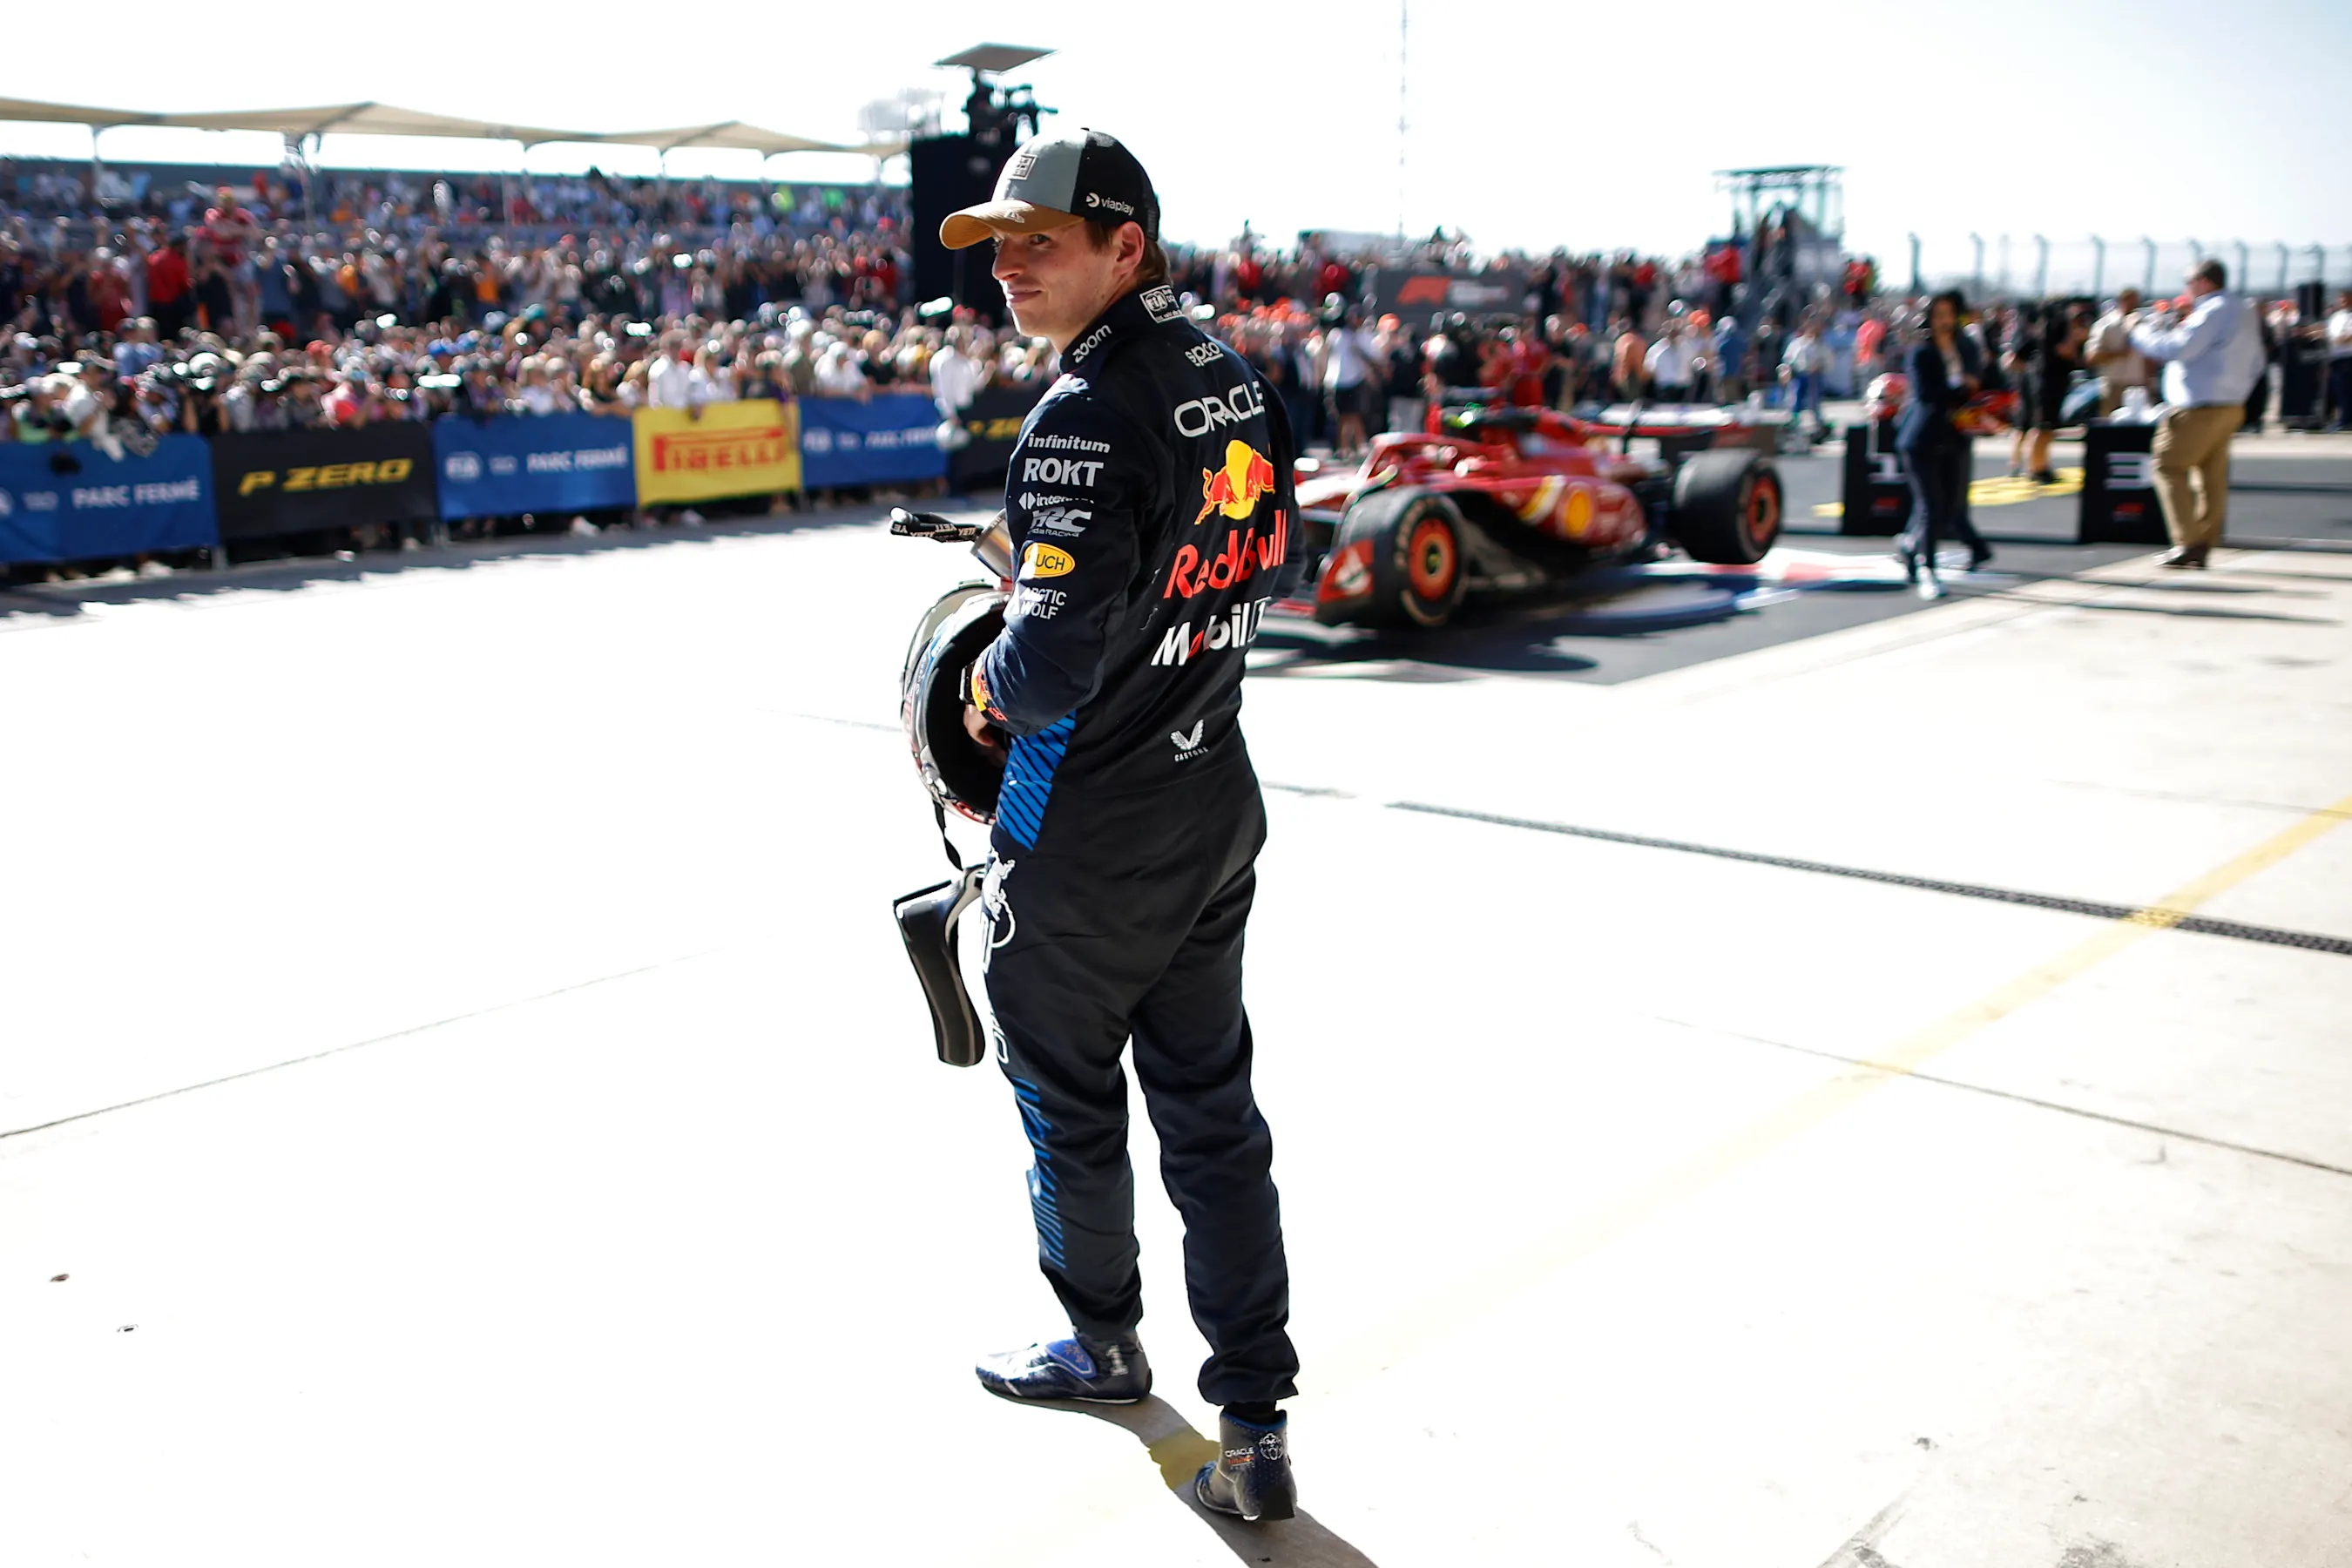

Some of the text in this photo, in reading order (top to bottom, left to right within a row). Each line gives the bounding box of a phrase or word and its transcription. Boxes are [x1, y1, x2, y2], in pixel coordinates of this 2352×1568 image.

[1101, 197, 1134, 216] viaplay
[1072, 325, 1112, 363] zoom
[1174, 381, 1265, 437] ORACLE
[652, 426, 787, 472] PIRELLI
[1028, 433, 1111, 453] infinitum
[238, 458, 413, 497] P ZERO
[1023, 457, 1105, 487] ROKT
[71, 485, 130, 510] PARC
[1030, 553, 1065, 571] UCH
[1021, 600, 1058, 620] WOLF
[1151, 602, 1250, 666] Mobil
[1106, 1344, 1128, 1376] 1
